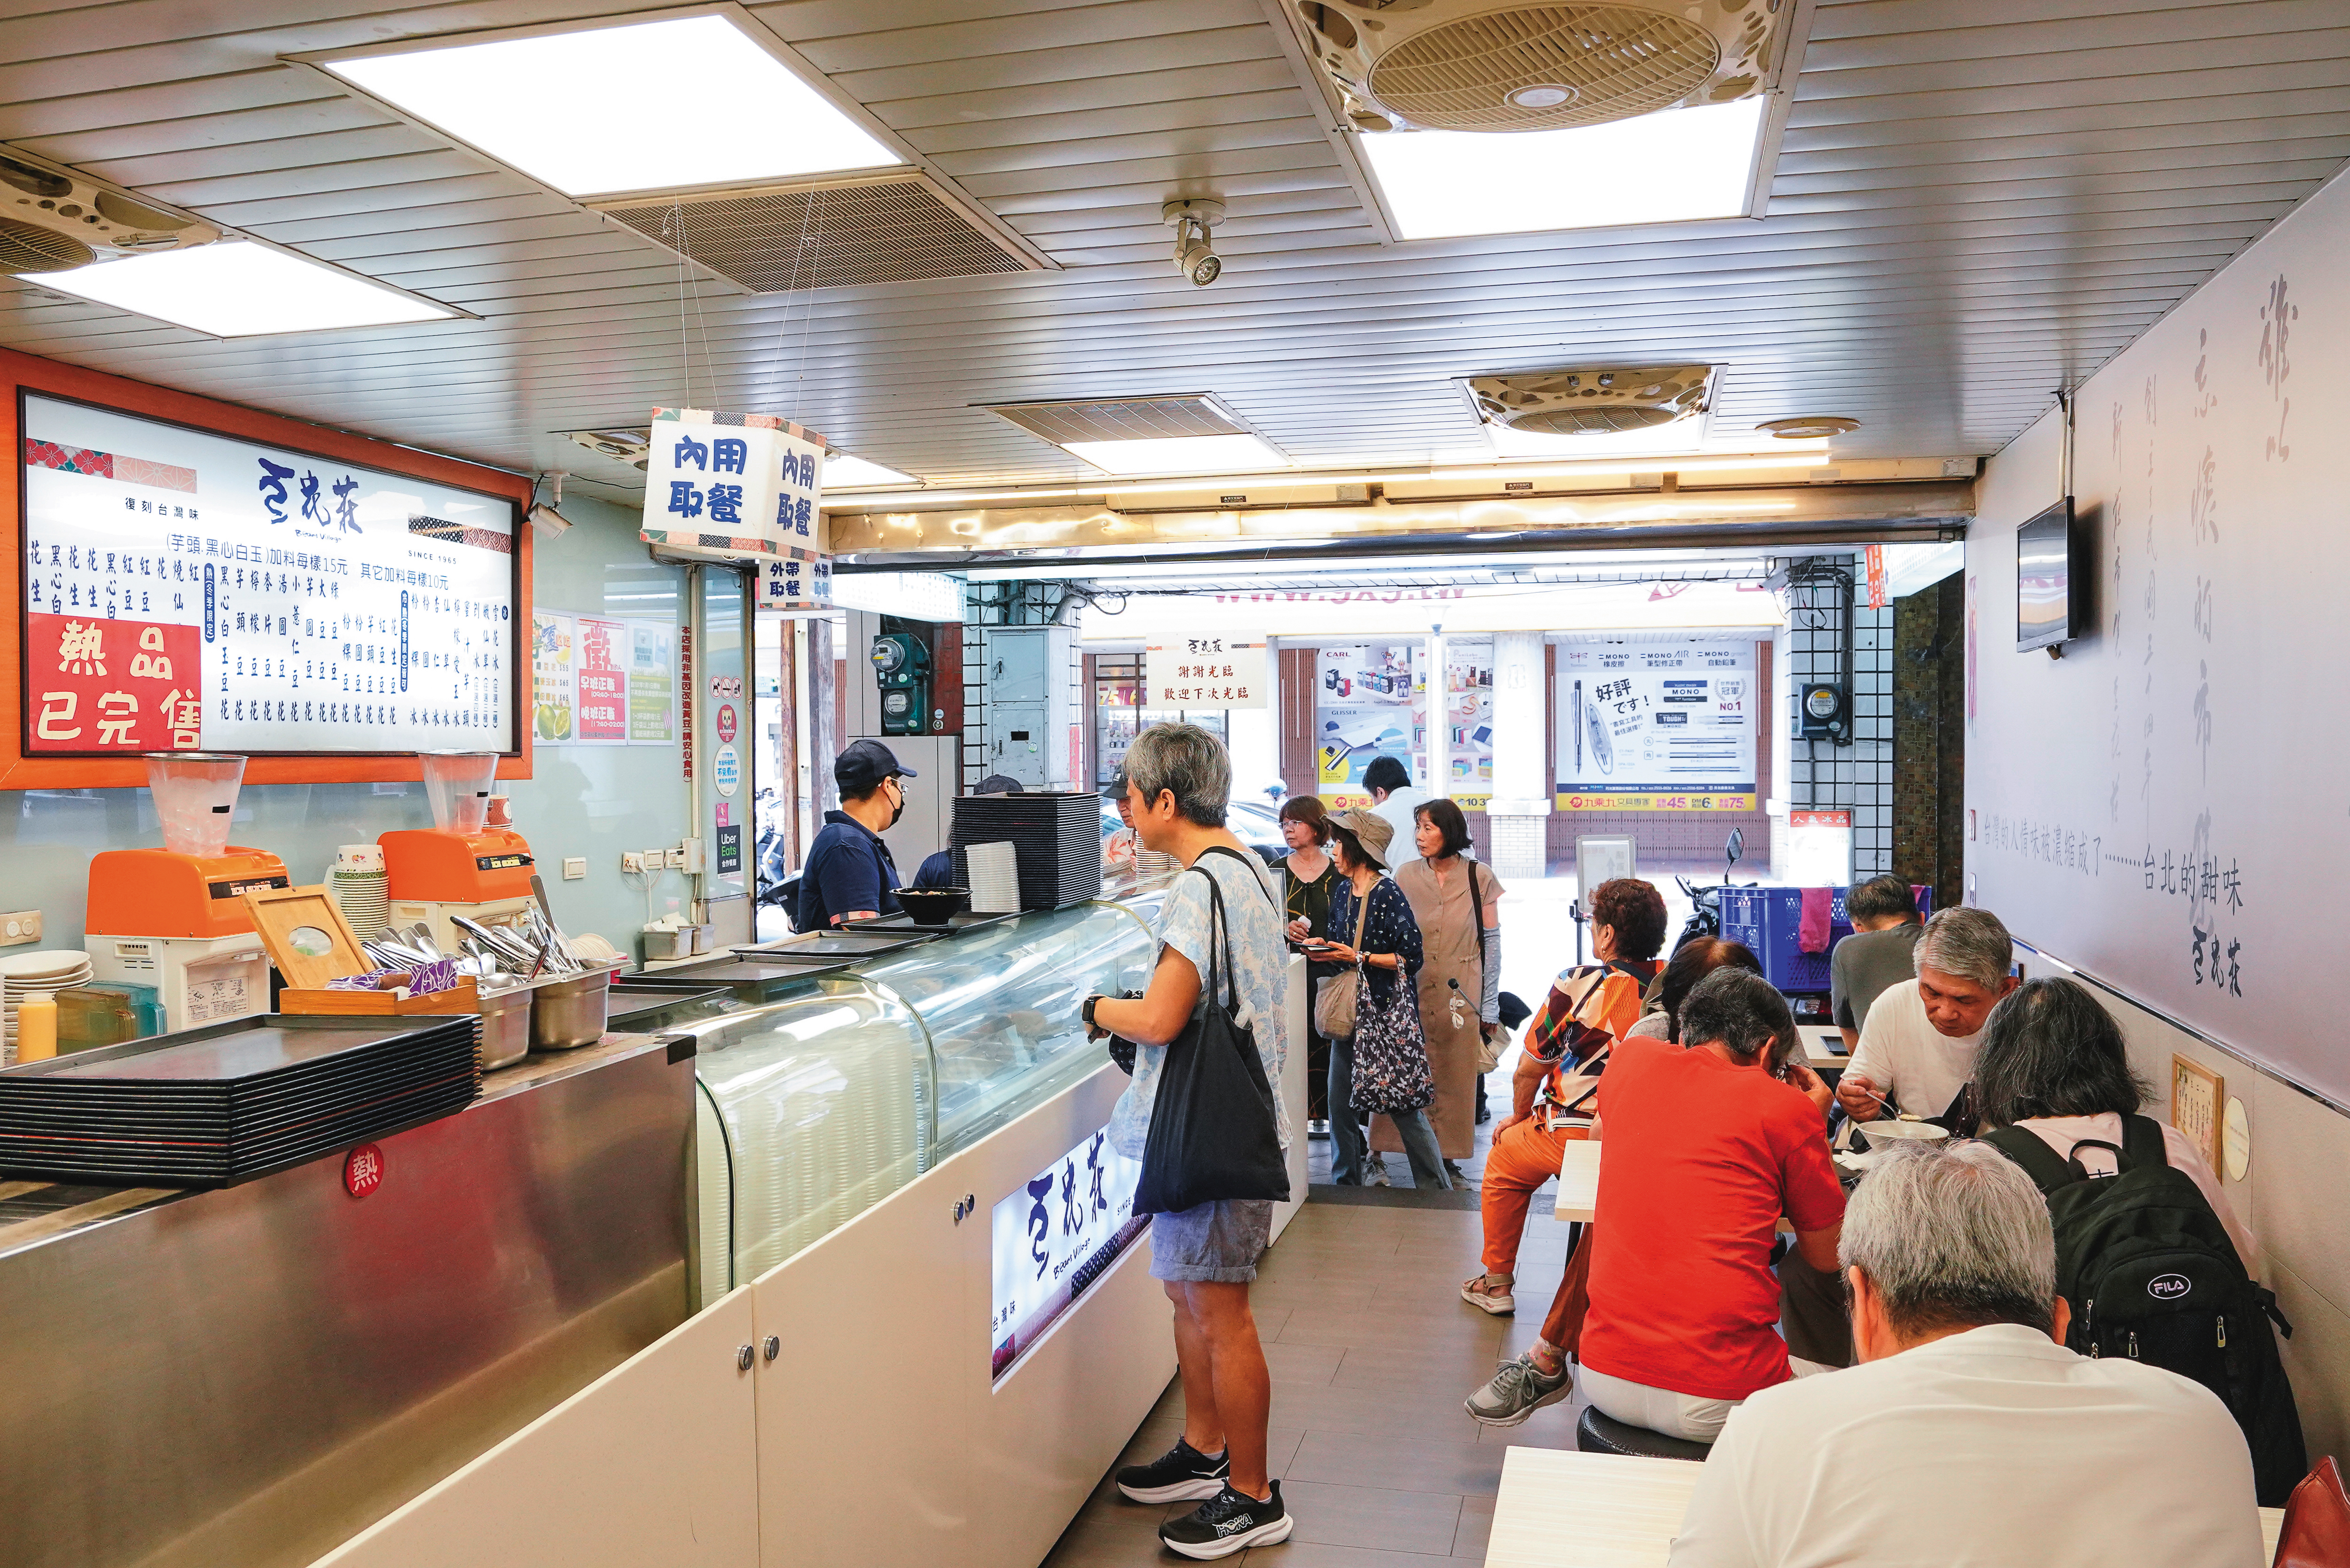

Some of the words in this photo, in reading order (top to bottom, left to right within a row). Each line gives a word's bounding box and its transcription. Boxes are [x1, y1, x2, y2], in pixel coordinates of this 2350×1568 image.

[125, 496, 200, 521] 復刻台灣味
[668, 481, 743, 524] 取餐
[777, 493, 812, 537] 取餐
[408, 549, 434, 561] SINCE
[439, 555, 457, 564] 1965
[360, 563, 449, 590] 其它加料每樣10元
[770, 561, 800, 577] 外帶
[814, 563, 829, 579] 外帶
[770, 580, 800, 597] 取餐
[58, 619, 174, 681] 熱品
[220, 566, 229, 720] 黑心白玉豆花
[235, 568, 245, 721] 芋頭豆花
[250, 569, 259, 721] 檸檬豆花
[278, 573, 287, 721] 湯圓豆花
[290, 575, 299, 722] 小薏仁豆花
[330, 581, 339, 722] 綠豆豆花
[1178, 665, 1234, 678] 謝謝光臨
[1164, 686, 1249, 700] 歡迎下次光臨
[1595, 678, 1632, 702] 好評
[1721, 687, 1740, 695] 冠軍
[1720, 701, 1741, 711] NO.1
[37, 688, 202, 749] 已完售
[1729, 797, 1744, 808] 75
[1793, 815, 1847, 823] 人氣冰品
[721, 833, 737, 845] Uber
[721, 846, 737, 857] Eats
[353, 1151, 378, 1191] 熱
[1117, 1196, 1131, 1216] SINCE
[1073, 1237, 1091, 1260] Village
[2153, 1280, 2185, 1294] FILA
[992, 1299, 1016, 1333] 台灣味
[1215, 1513, 1253, 1538] HOKA
